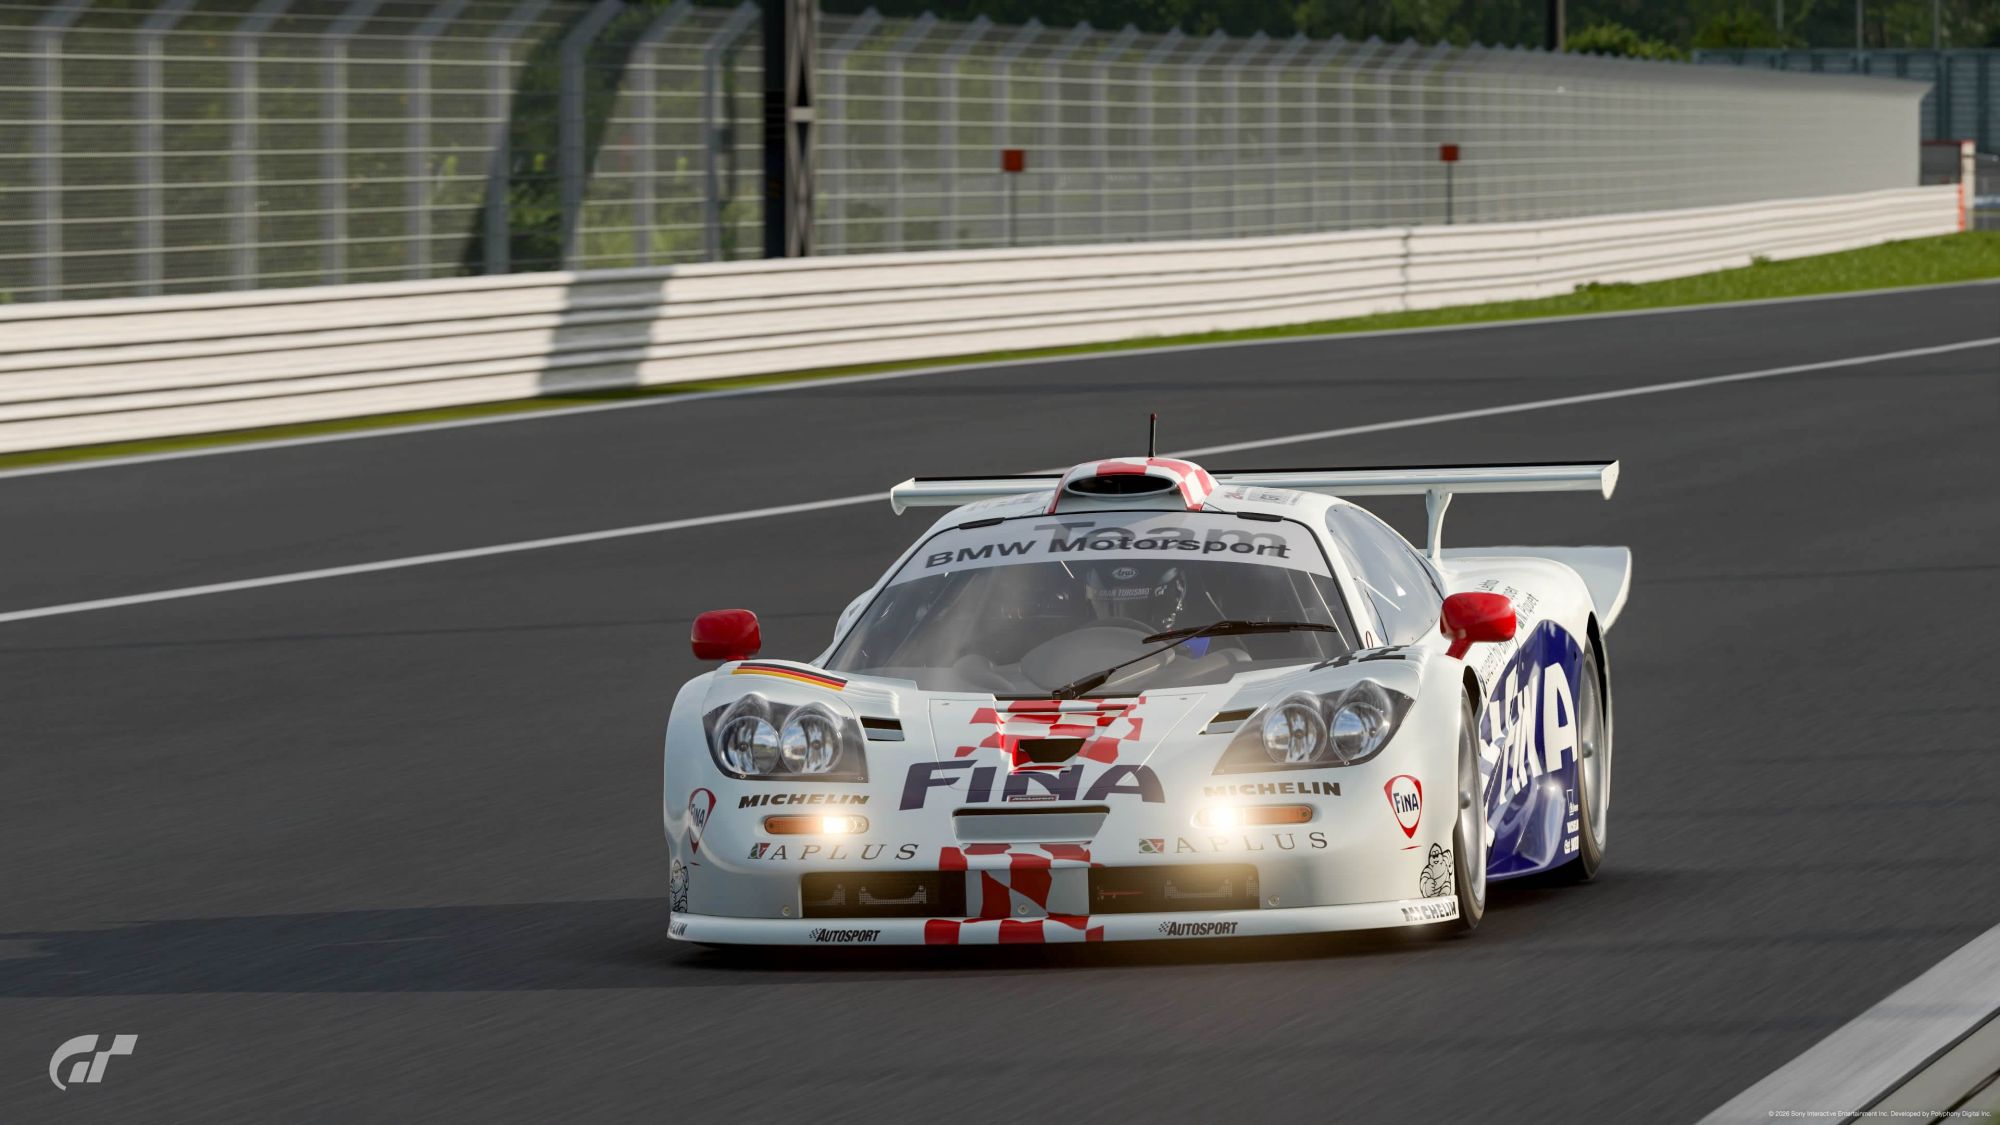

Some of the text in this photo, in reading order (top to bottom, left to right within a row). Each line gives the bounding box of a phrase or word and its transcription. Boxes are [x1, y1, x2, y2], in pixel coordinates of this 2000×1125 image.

[925, 535, 1291, 569] BMW Motorsport
[1034, 521, 1288, 557] Team
[899, 759, 1166, 811] FINA
[1203, 781, 1342, 797] MICHELIN
[738, 793, 870, 809] MICHELIN
[1393, 789, 1419, 815] FINA
[690, 803, 706, 829] FINA
[816, 927, 881, 943] AUTOSPORT
[1166, 921, 1238, 937] AUTOSPORT
